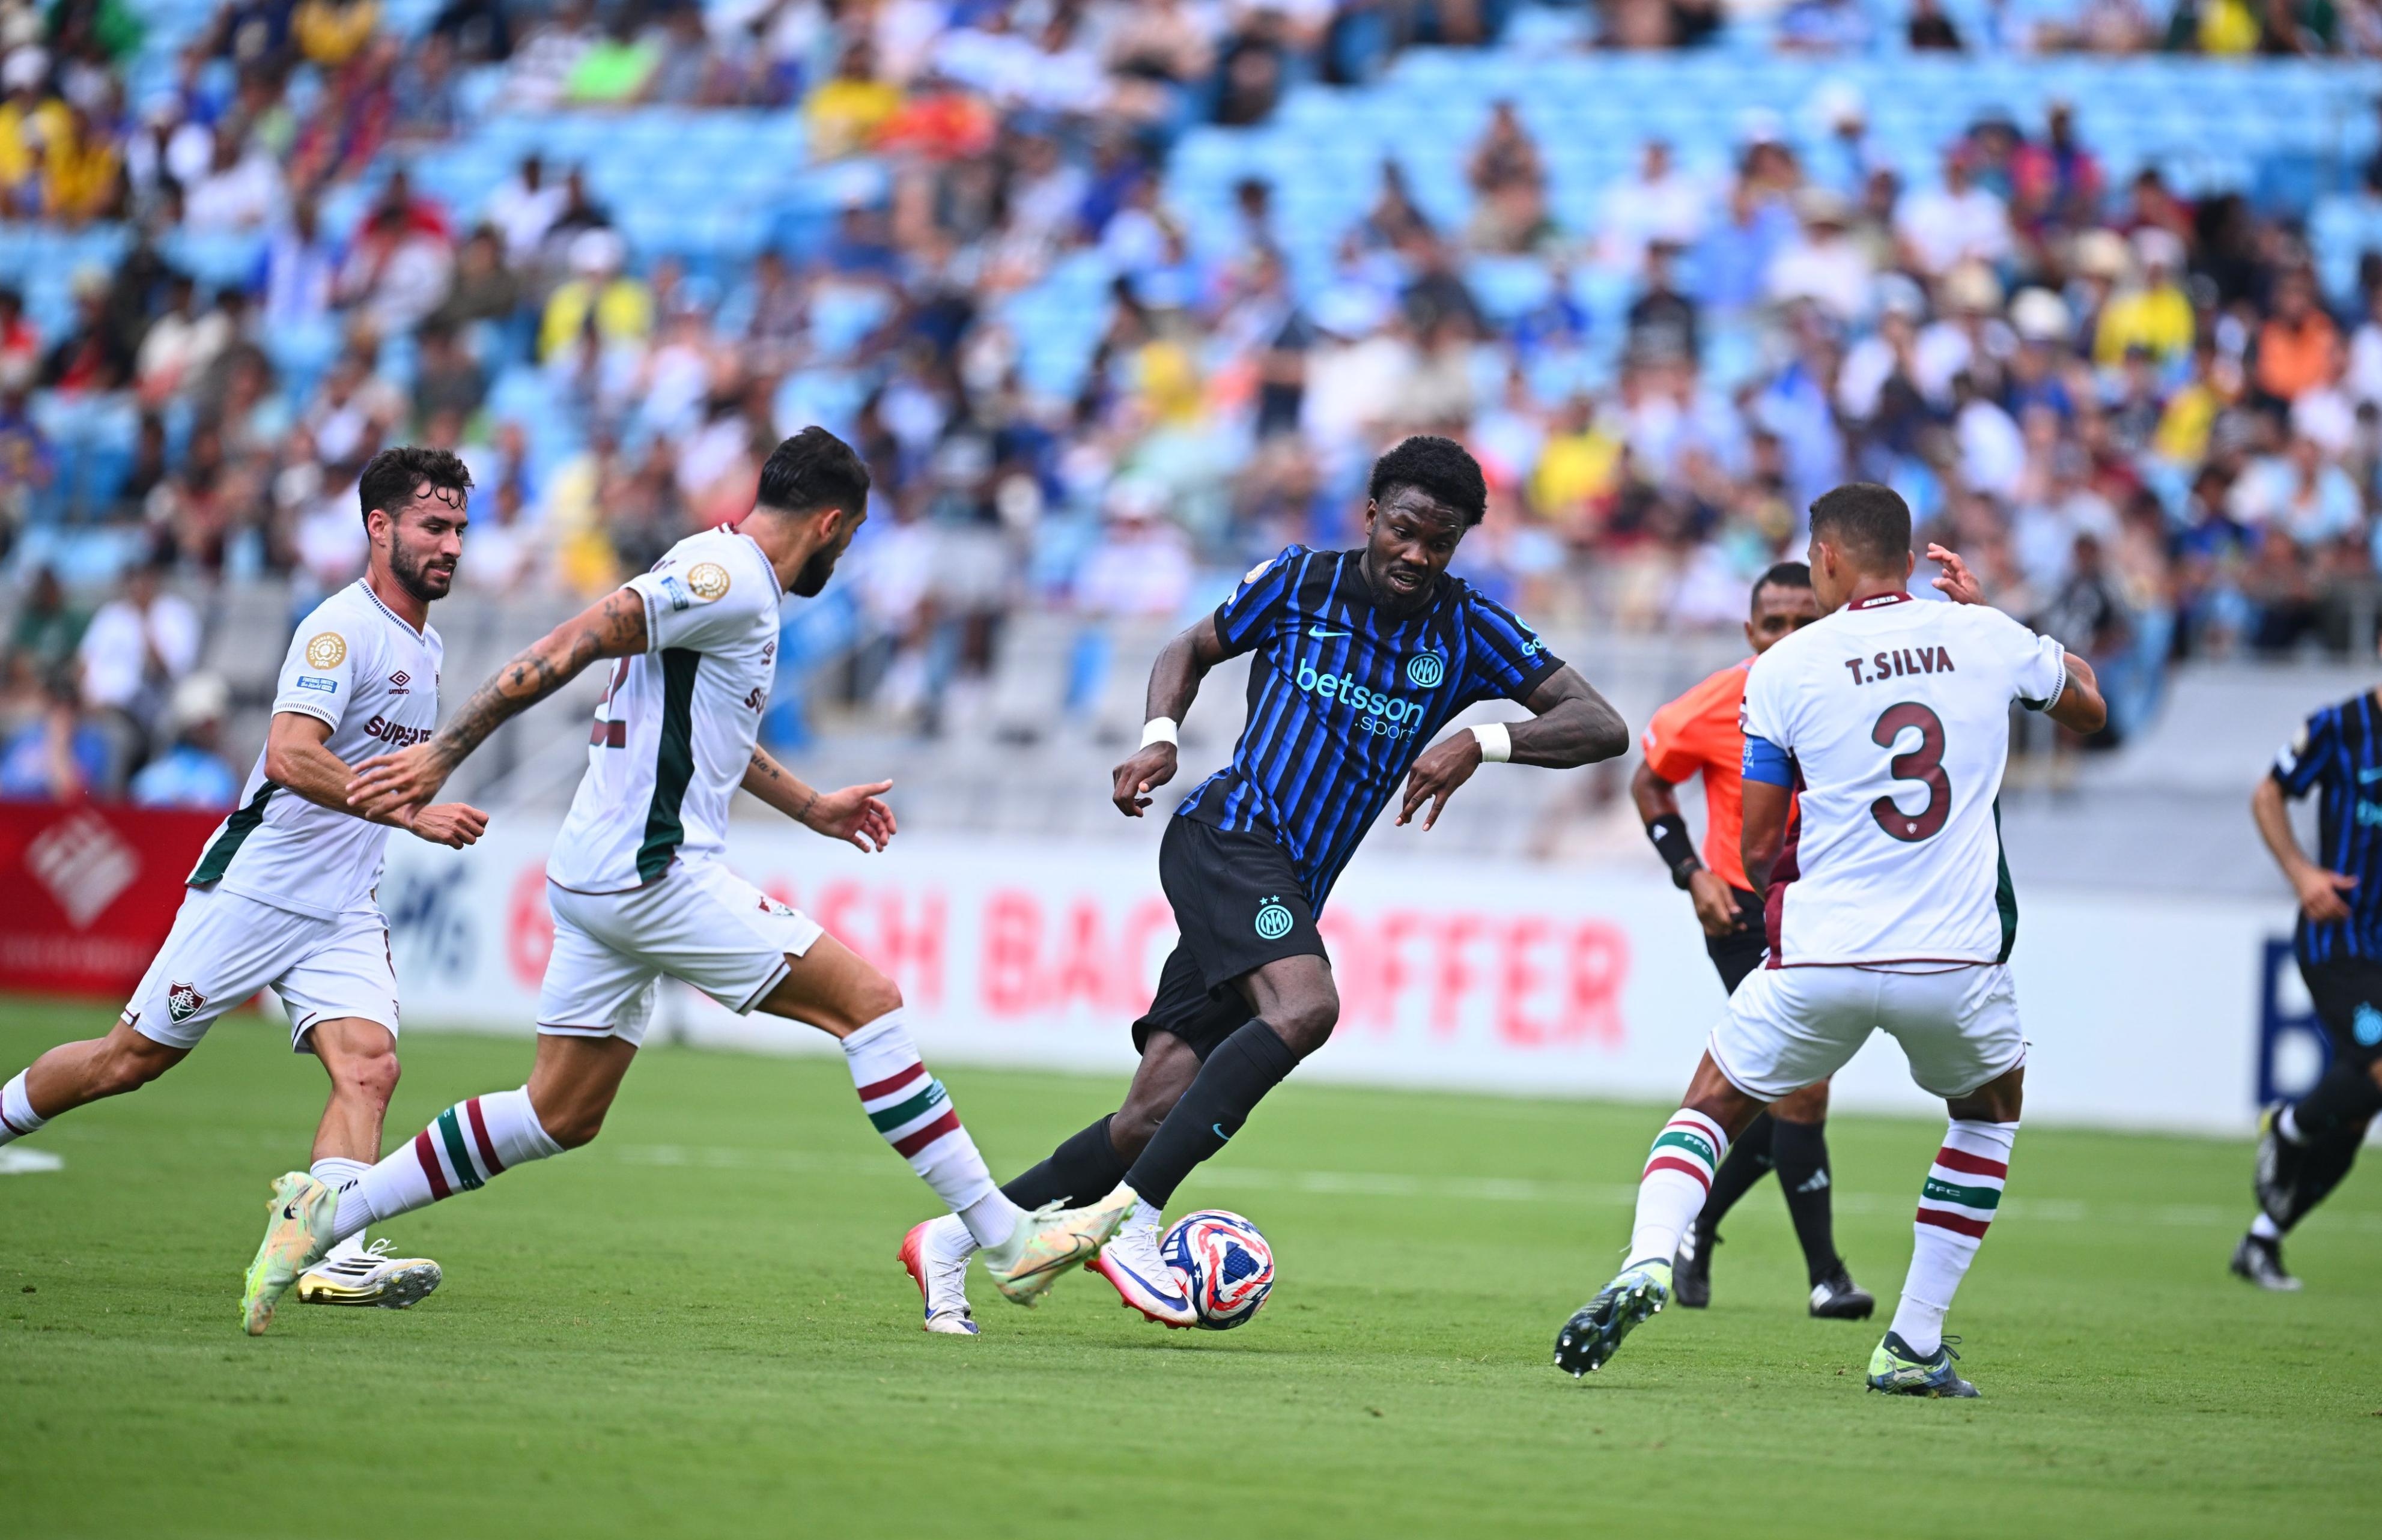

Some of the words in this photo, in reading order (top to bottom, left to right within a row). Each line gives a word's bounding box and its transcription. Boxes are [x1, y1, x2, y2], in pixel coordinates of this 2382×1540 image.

[1296, 658, 1424, 727] betsson
[1845, 646, 1955, 685] T.SILVA
[1870, 701, 1952, 843] 3
[980, 888, 1181, 1020] BAC
[1684, 1135, 1710, 1154] FFC
[1927, 1183, 1961, 1196] FFC
